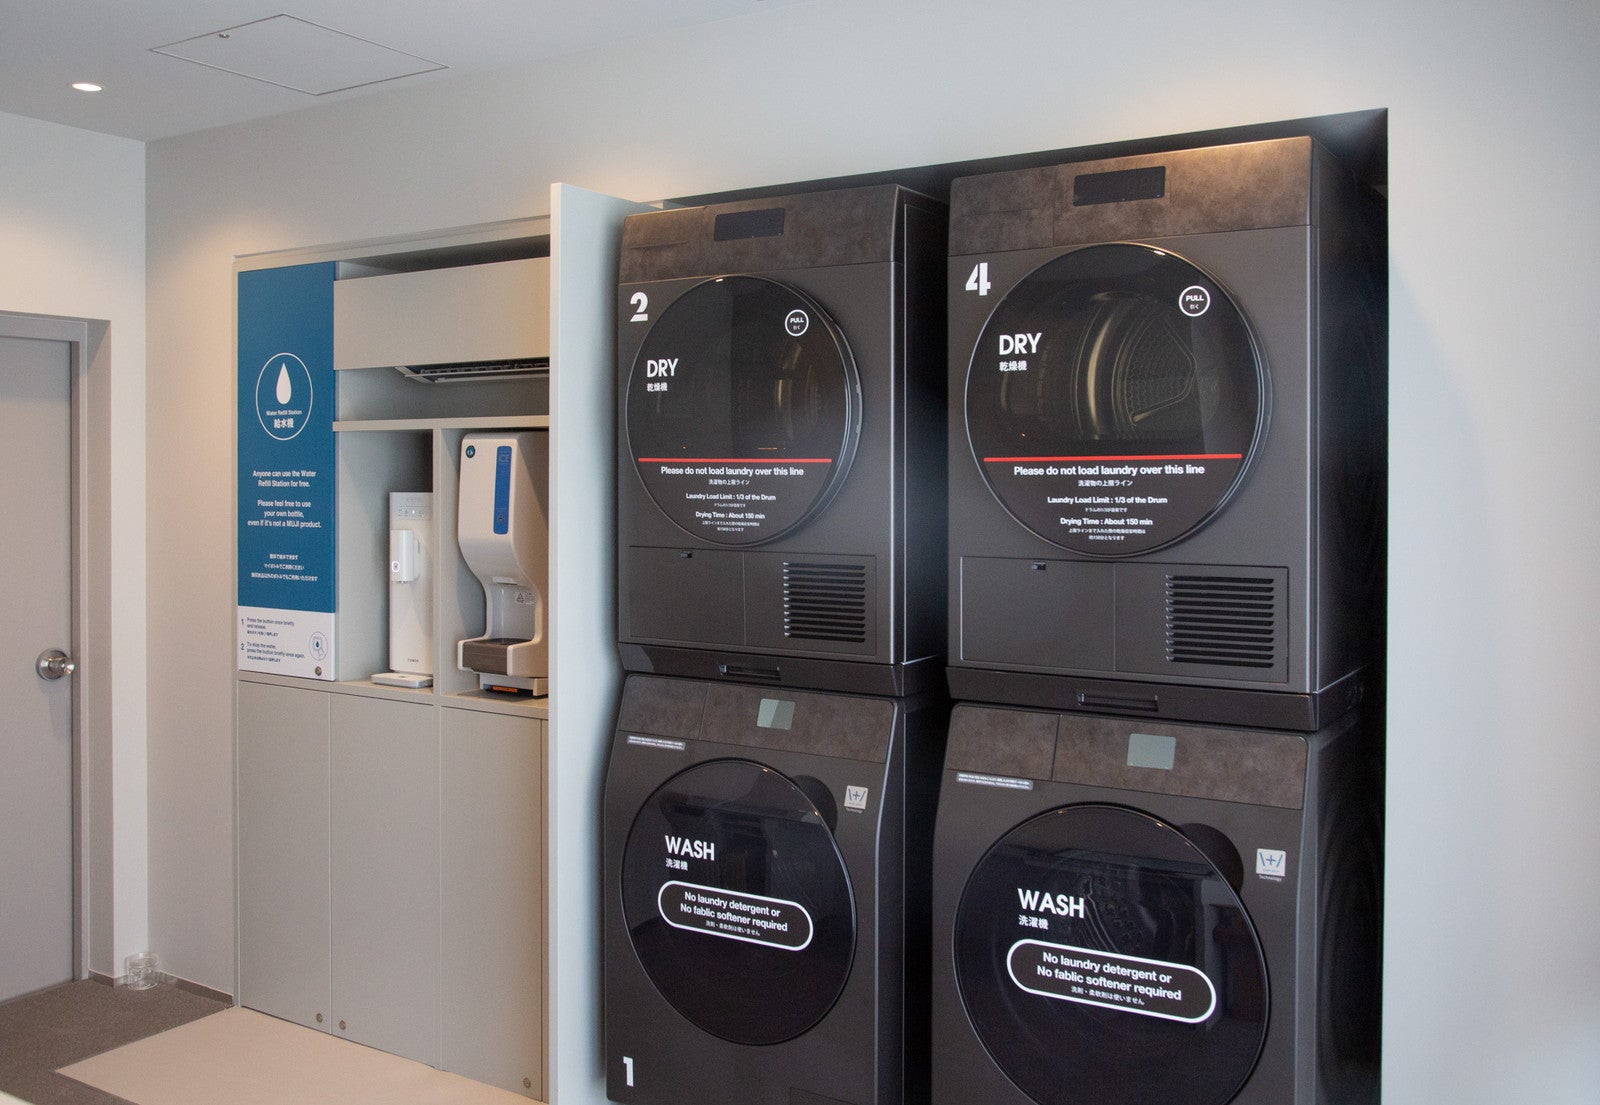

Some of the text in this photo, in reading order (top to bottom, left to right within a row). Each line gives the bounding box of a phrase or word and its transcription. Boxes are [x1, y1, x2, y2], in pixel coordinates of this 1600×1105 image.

[965, 262, 992, 296] 4
[630, 292, 648, 322] 2
[999, 332, 1042, 355] DRY
[647, 358, 678, 378] DRY
[999, 361, 1028, 372] 乾燥機
[647, 382, 668, 392] 乾燥機
[274, 418, 294, 428] 給水機
[253, 470, 271, 478] Anyone
[661, 466, 683, 474] Please
[726, 467, 753, 476] laundry
[773, 467, 788, 475] this
[789, 467, 804, 475] line
[1014, 466, 1044, 475] Please
[1046, 466, 1058, 475] do
[1060, 466, 1076, 475] not
[1078, 466, 1099, 475] load
[1101, 465, 1138, 476] laundry
[1164, 465, 1184, 474] this
[1186, 465, 1205, 474] line
[1060, 518, 1082, 526] Drying
[665, 835, 714, 861] WASH
[665, 858, 688, 871] 洗濯機
[684, 892, 696, 901] No
[698, 894, 728, 909] laundry
[729, 900, 769, 915] detergent
[1017, 888, 1084, 918] WASH
[680, 903, 788, 931] No fablic softener required
[1019, 915, 1049, 930] 洗濯機
[1043, 952, 1172, 984] No laundry detergent or
[1037, 965, 1182, 1000] No fablic softener required
[623, 1056, 634, 1087] 1
